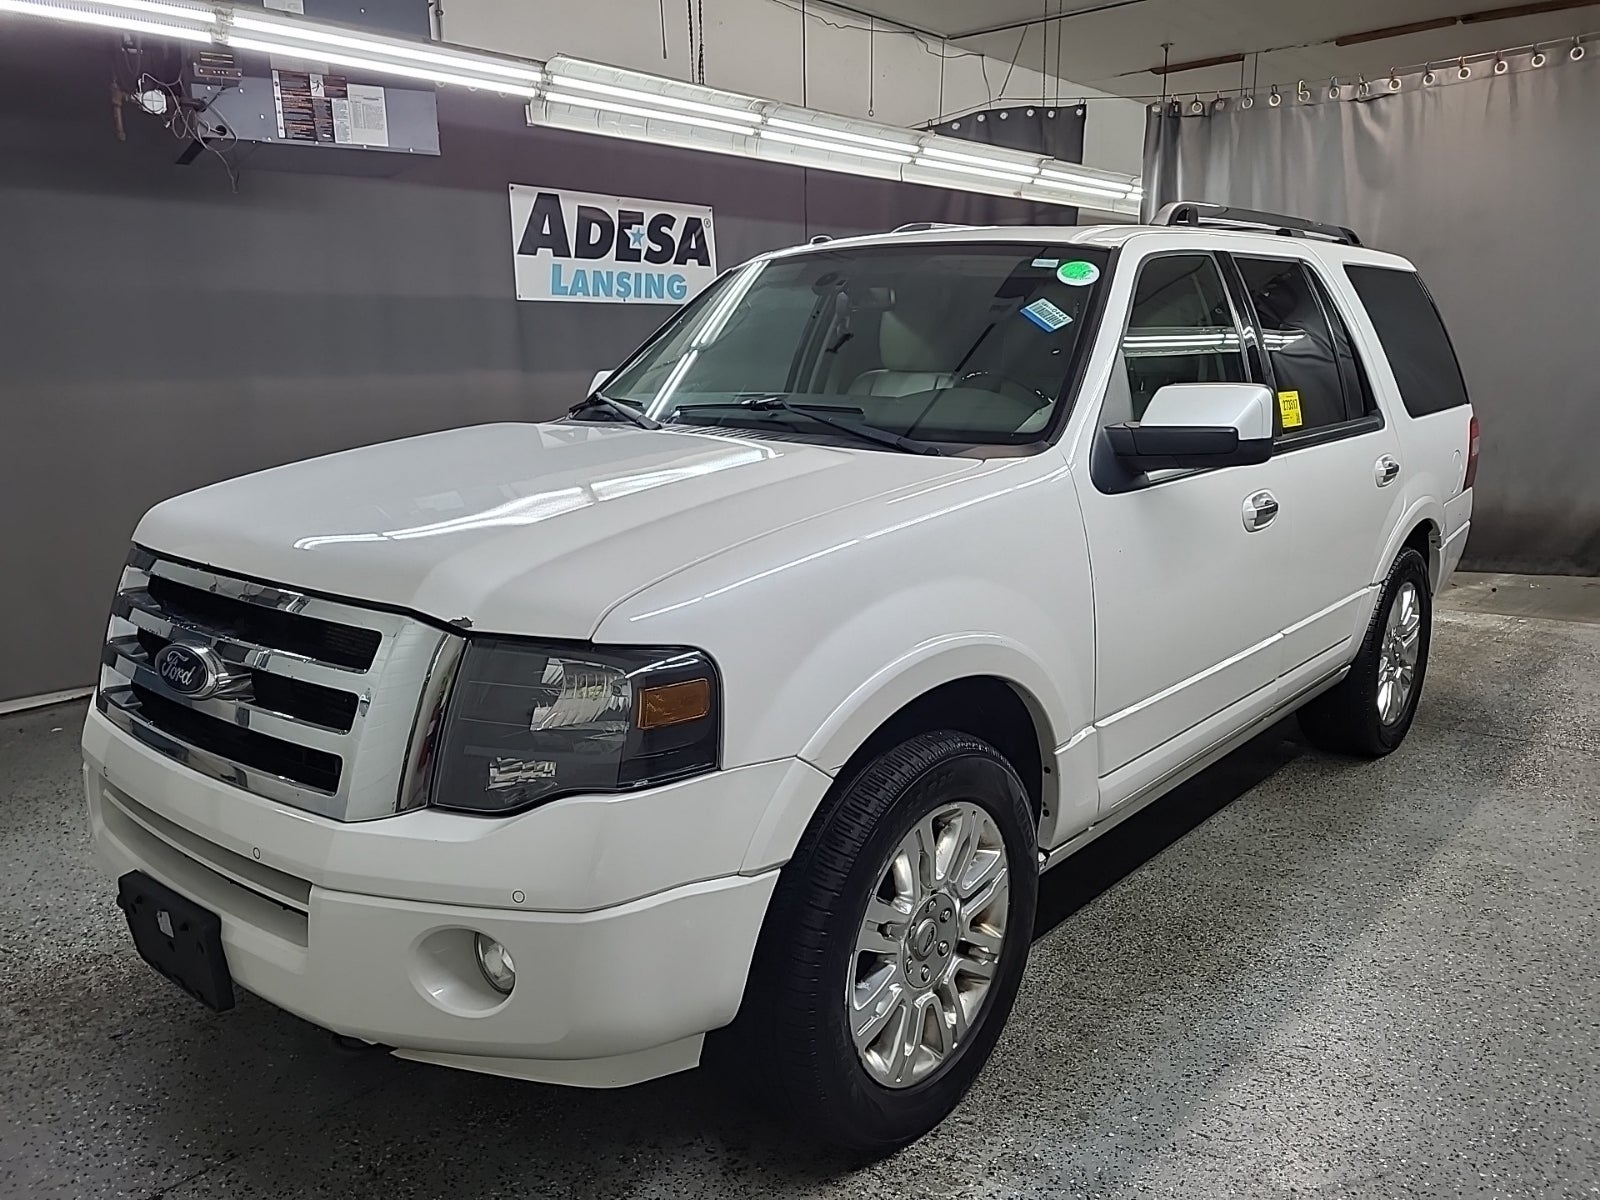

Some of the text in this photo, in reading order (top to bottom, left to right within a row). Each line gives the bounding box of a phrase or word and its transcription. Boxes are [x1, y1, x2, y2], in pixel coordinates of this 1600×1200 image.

[517, 192, 711, 267] ADESA
[552, 263, 688, 300] LANSING
[161, 650, 196, 686] Ford
